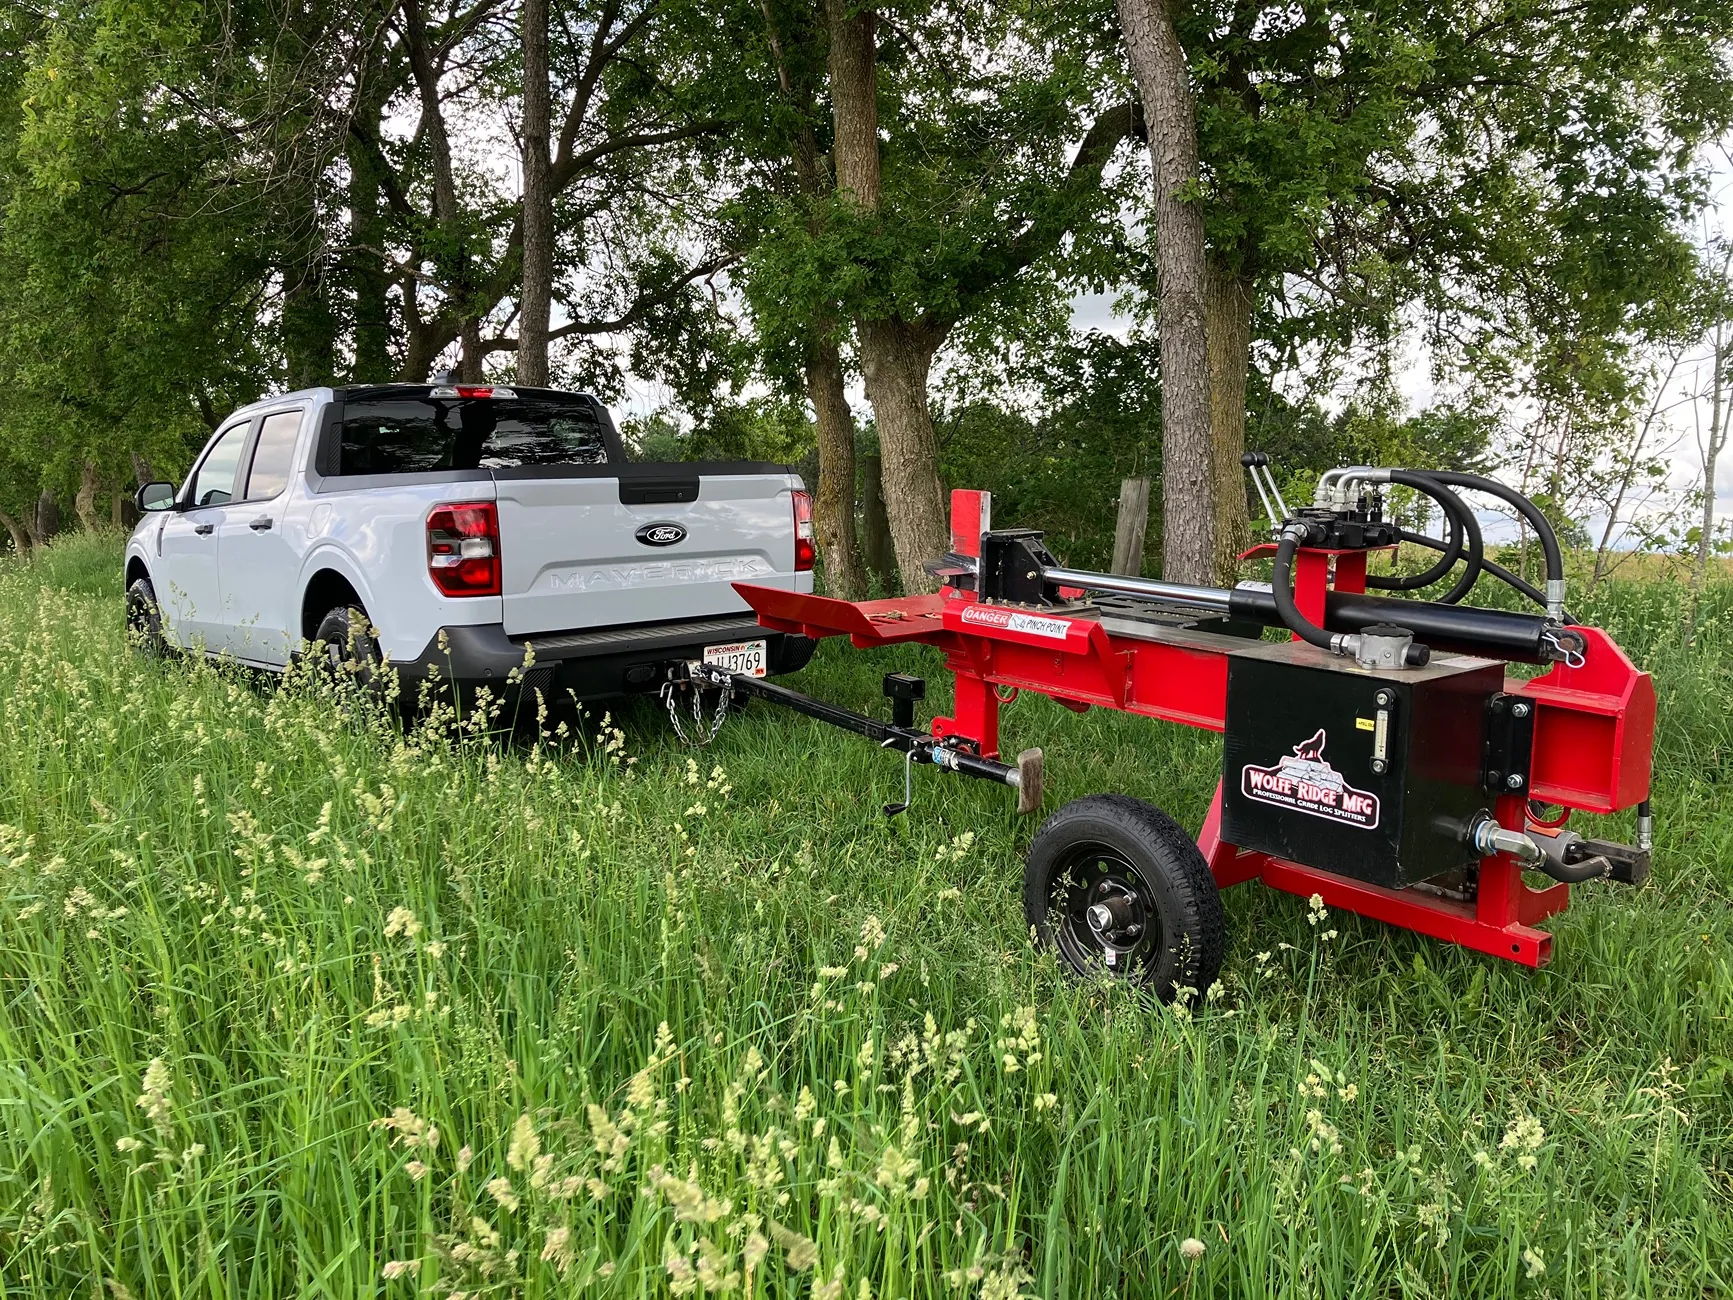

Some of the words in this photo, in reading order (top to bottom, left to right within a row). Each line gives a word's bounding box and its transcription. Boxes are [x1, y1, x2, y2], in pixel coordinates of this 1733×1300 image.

[653, 528, 676, 540] Ford
[550, 559, 758, 589] MAVERICK
[965, 609, 1009, 625] DANGER
[1026, 619, 1045, 631] PINCH
[1046, 622, 1067, 635] POINT
[706, 644, 740, 655] WISCONSIN
[1249, 769, 1293, 795] WOLFE
[1297, 781, 1337, 806] RIDGE
[1342, 791, 1373, 815] MFG
[1253, 788, 1296, 805] PROFESSIONAL
[1297, 799, 1319, 811] GRADE
[1319, 805, 1333, 815] LOG
[1334, 808, 1366, 823] SPLITTERS
